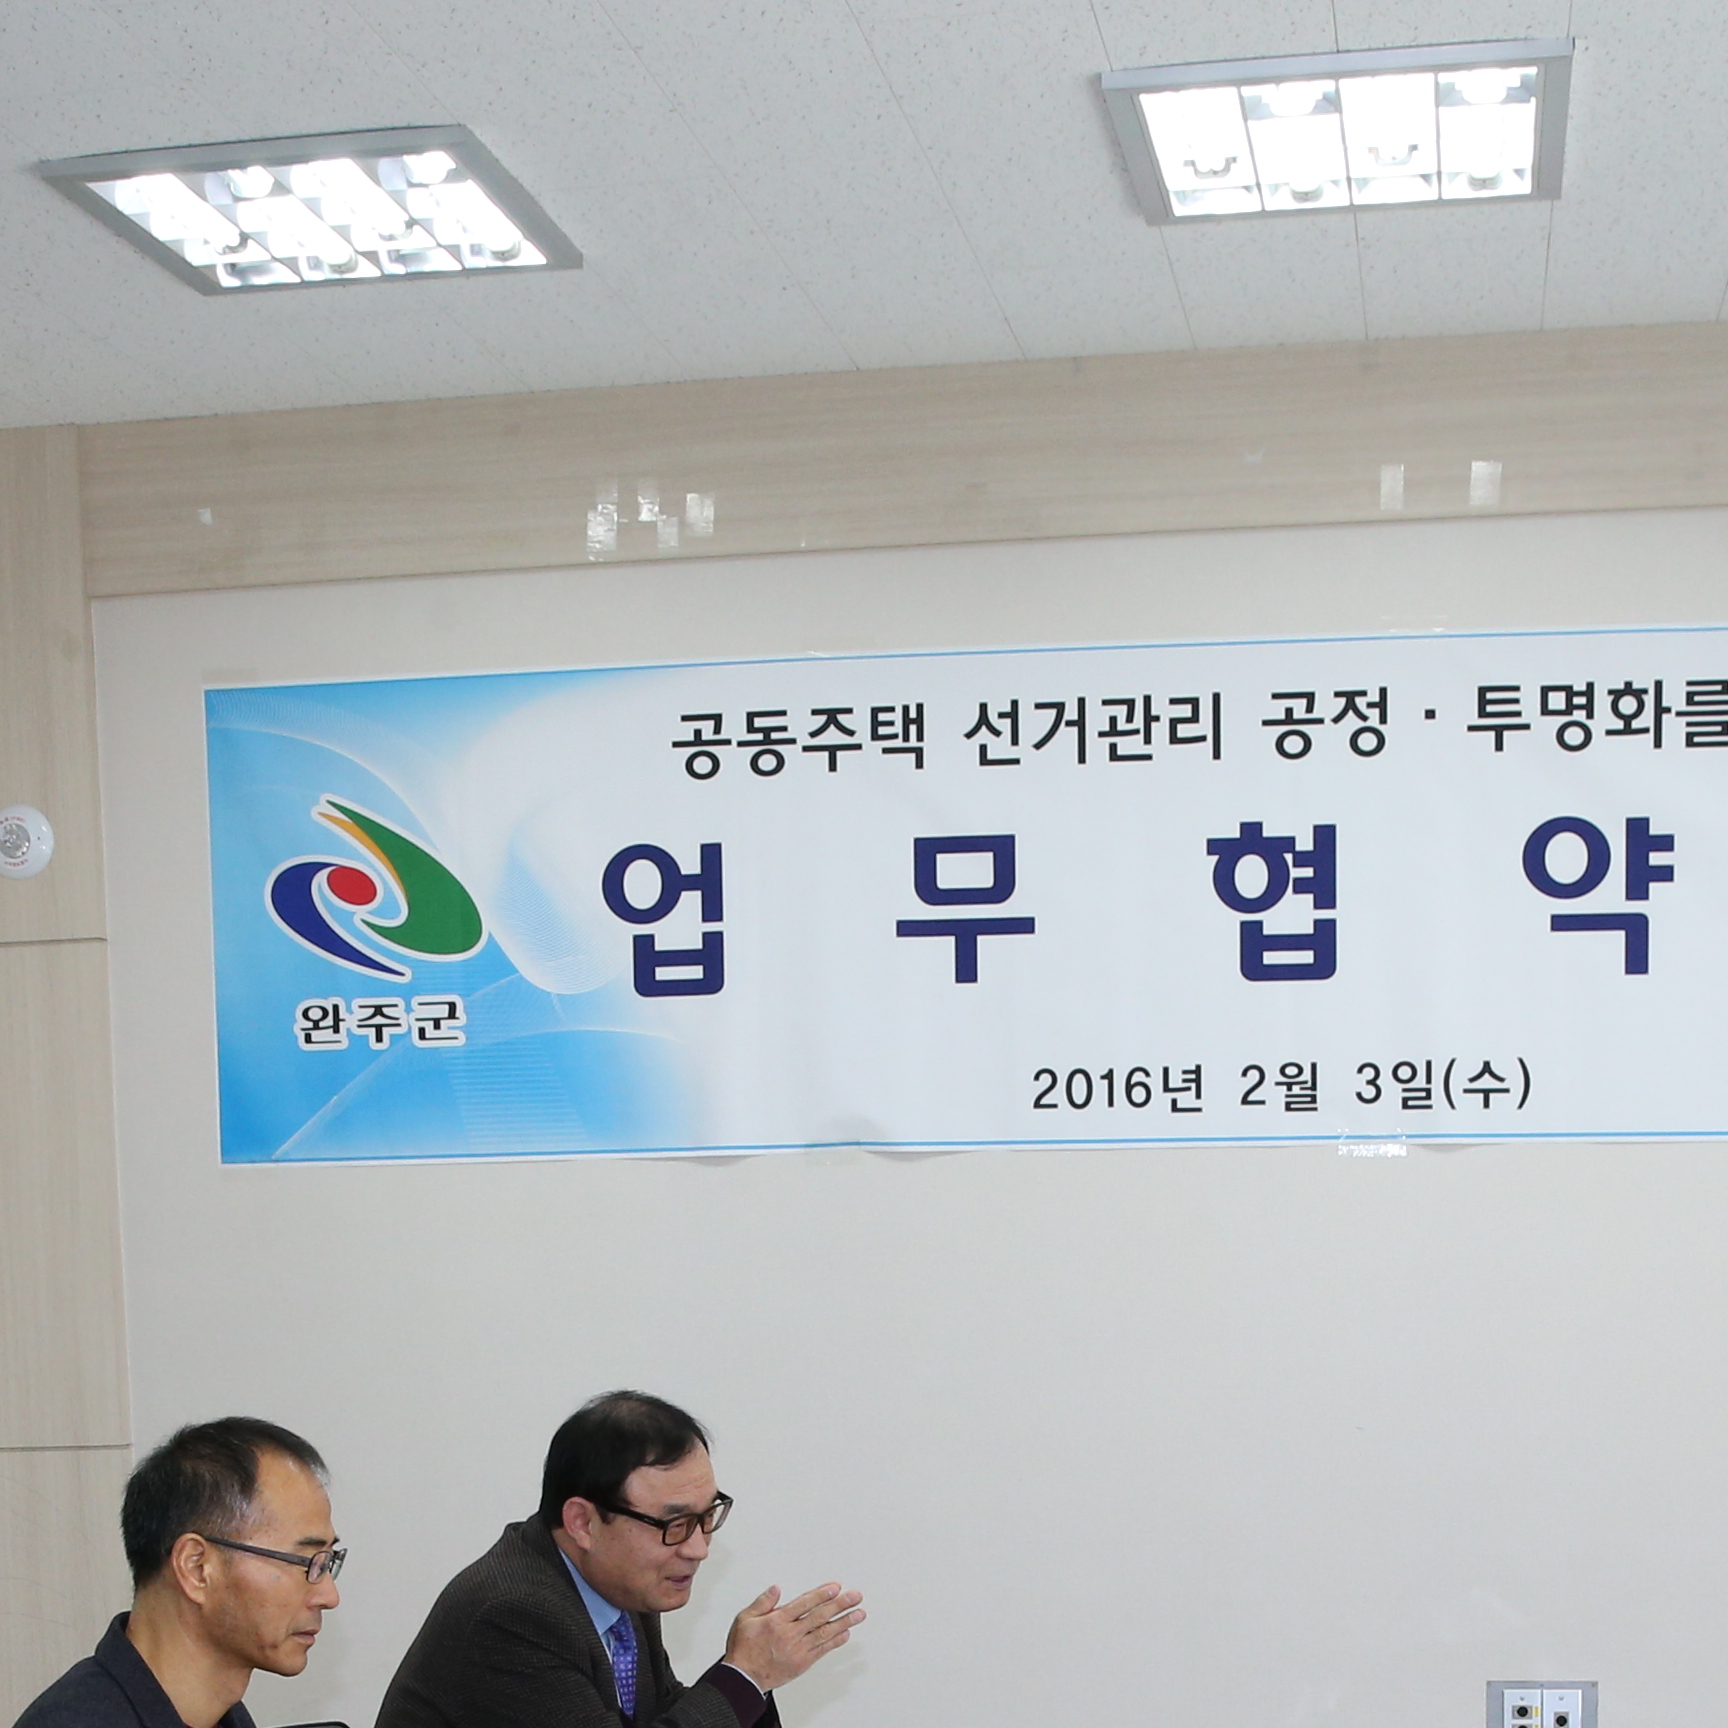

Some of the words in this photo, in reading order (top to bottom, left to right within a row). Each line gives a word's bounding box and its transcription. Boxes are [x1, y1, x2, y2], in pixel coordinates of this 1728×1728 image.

[671, 702, 925, 780] 공동주택
[963, 692, 1222, 766] 선거관리
[1260, 686, 1389, 760] 공정
[300, 1001, 462, 1045] 완주군
[1033, 1064, 1203, 1113] 2016년
[1241, 1062, 1317, 1112] 2월
[1356, 1058, 1532, 1110] 3일(수)
